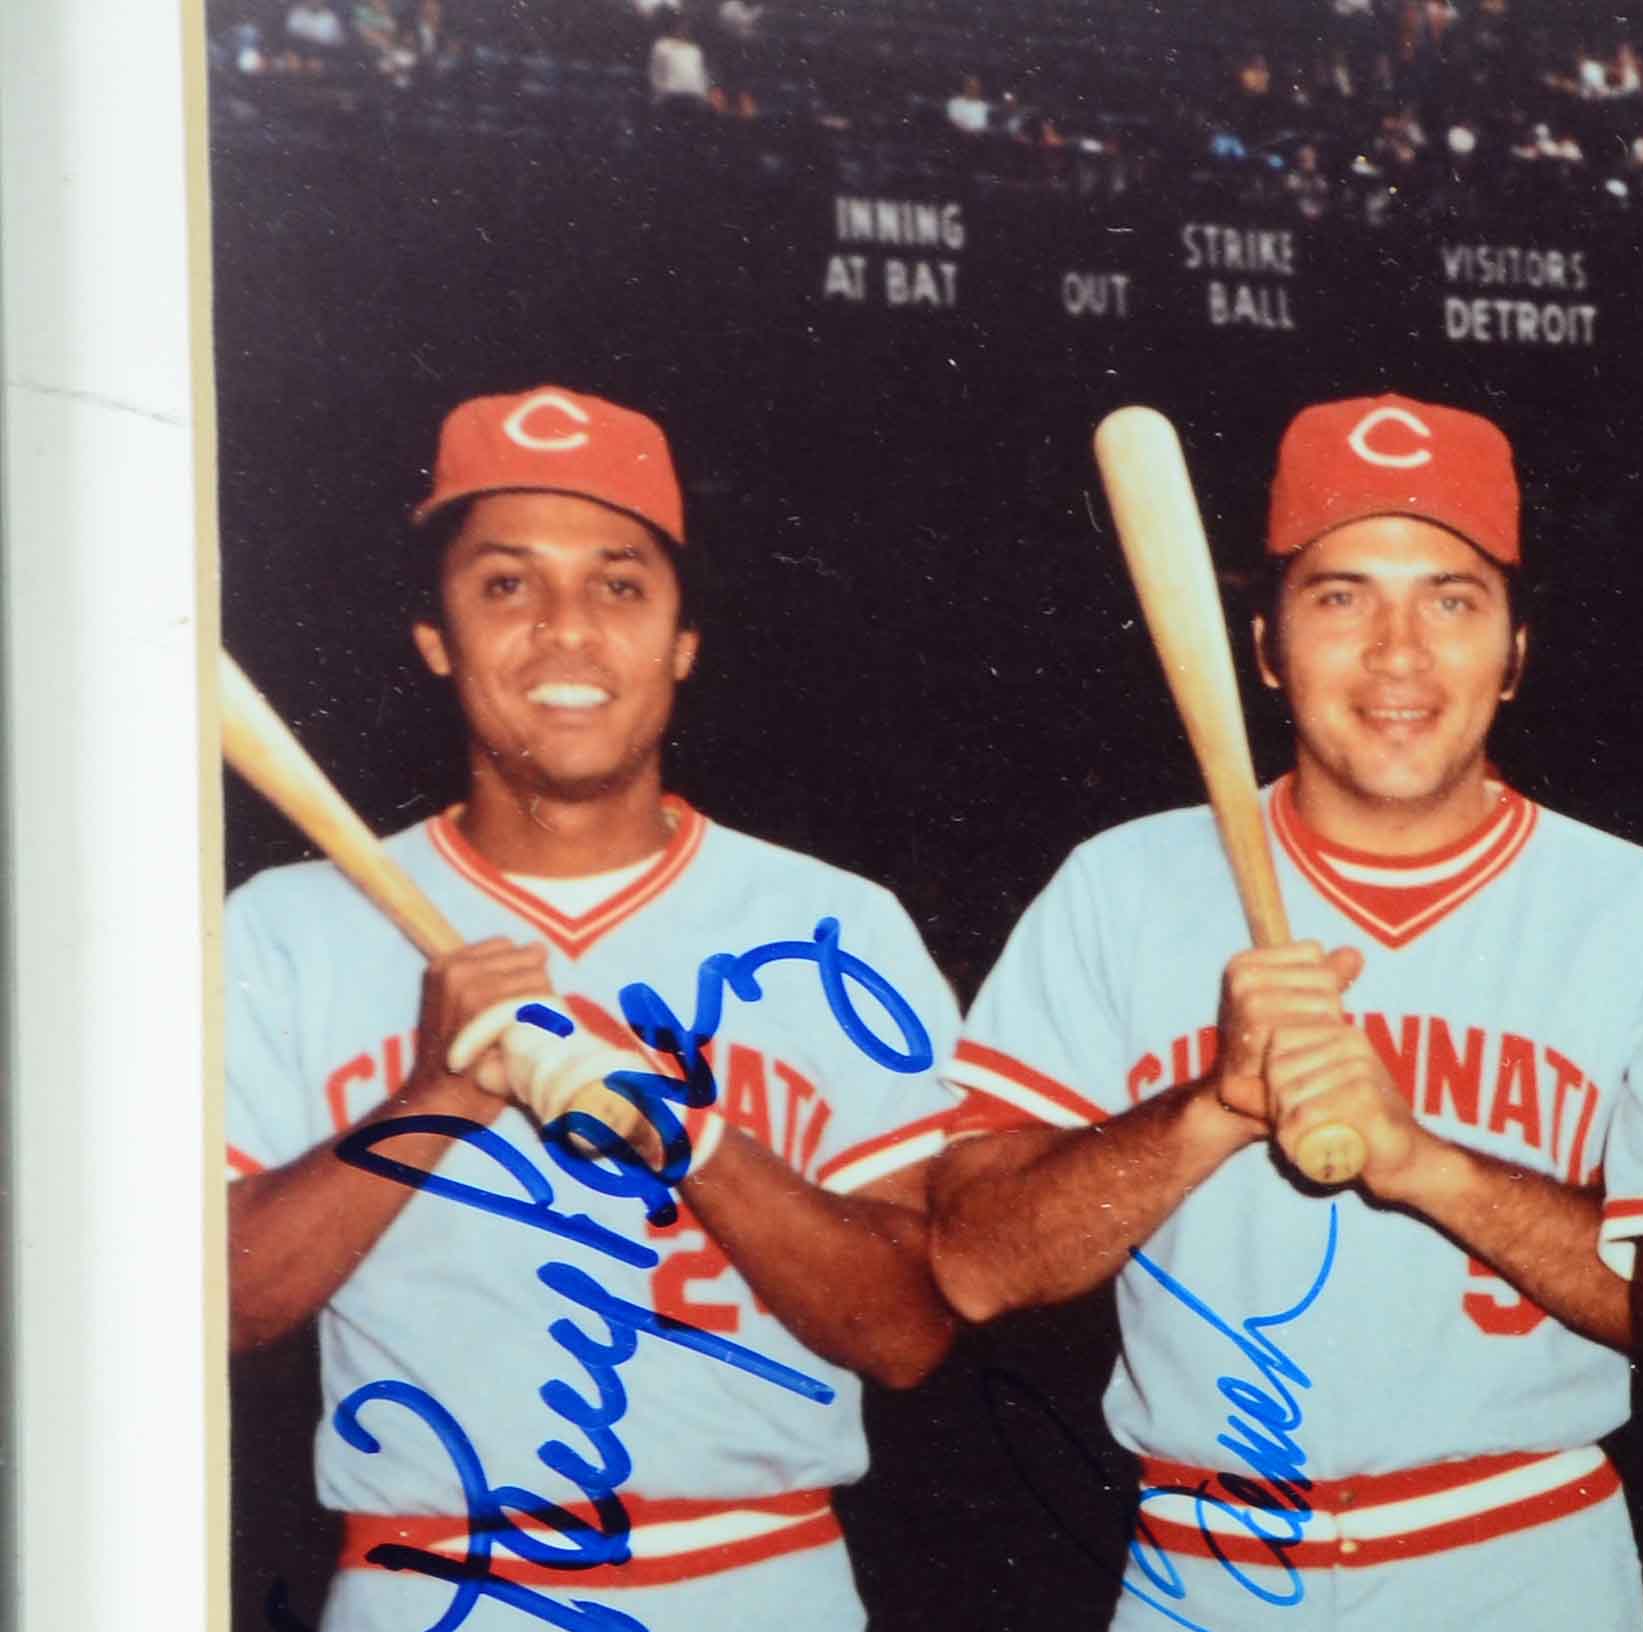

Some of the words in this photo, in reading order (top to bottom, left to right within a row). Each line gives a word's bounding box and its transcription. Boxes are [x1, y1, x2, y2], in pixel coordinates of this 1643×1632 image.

[838, 197, 964, 249] INNING
[1182, 224, 1294, 276] STRIKE
[1440, 246, 1588, 290] VISITORS
[825, 256, 866, 300] AT
[885, 259, 957, 305] BAT
[1063, 273, 1129, 318] OUT
[1209, 280, 1295, 331] BALL
[1446, 298, 1597, 344] DETROIT
[503, 394, 590, 450] C
[1348, 406, 1432, 468] C
